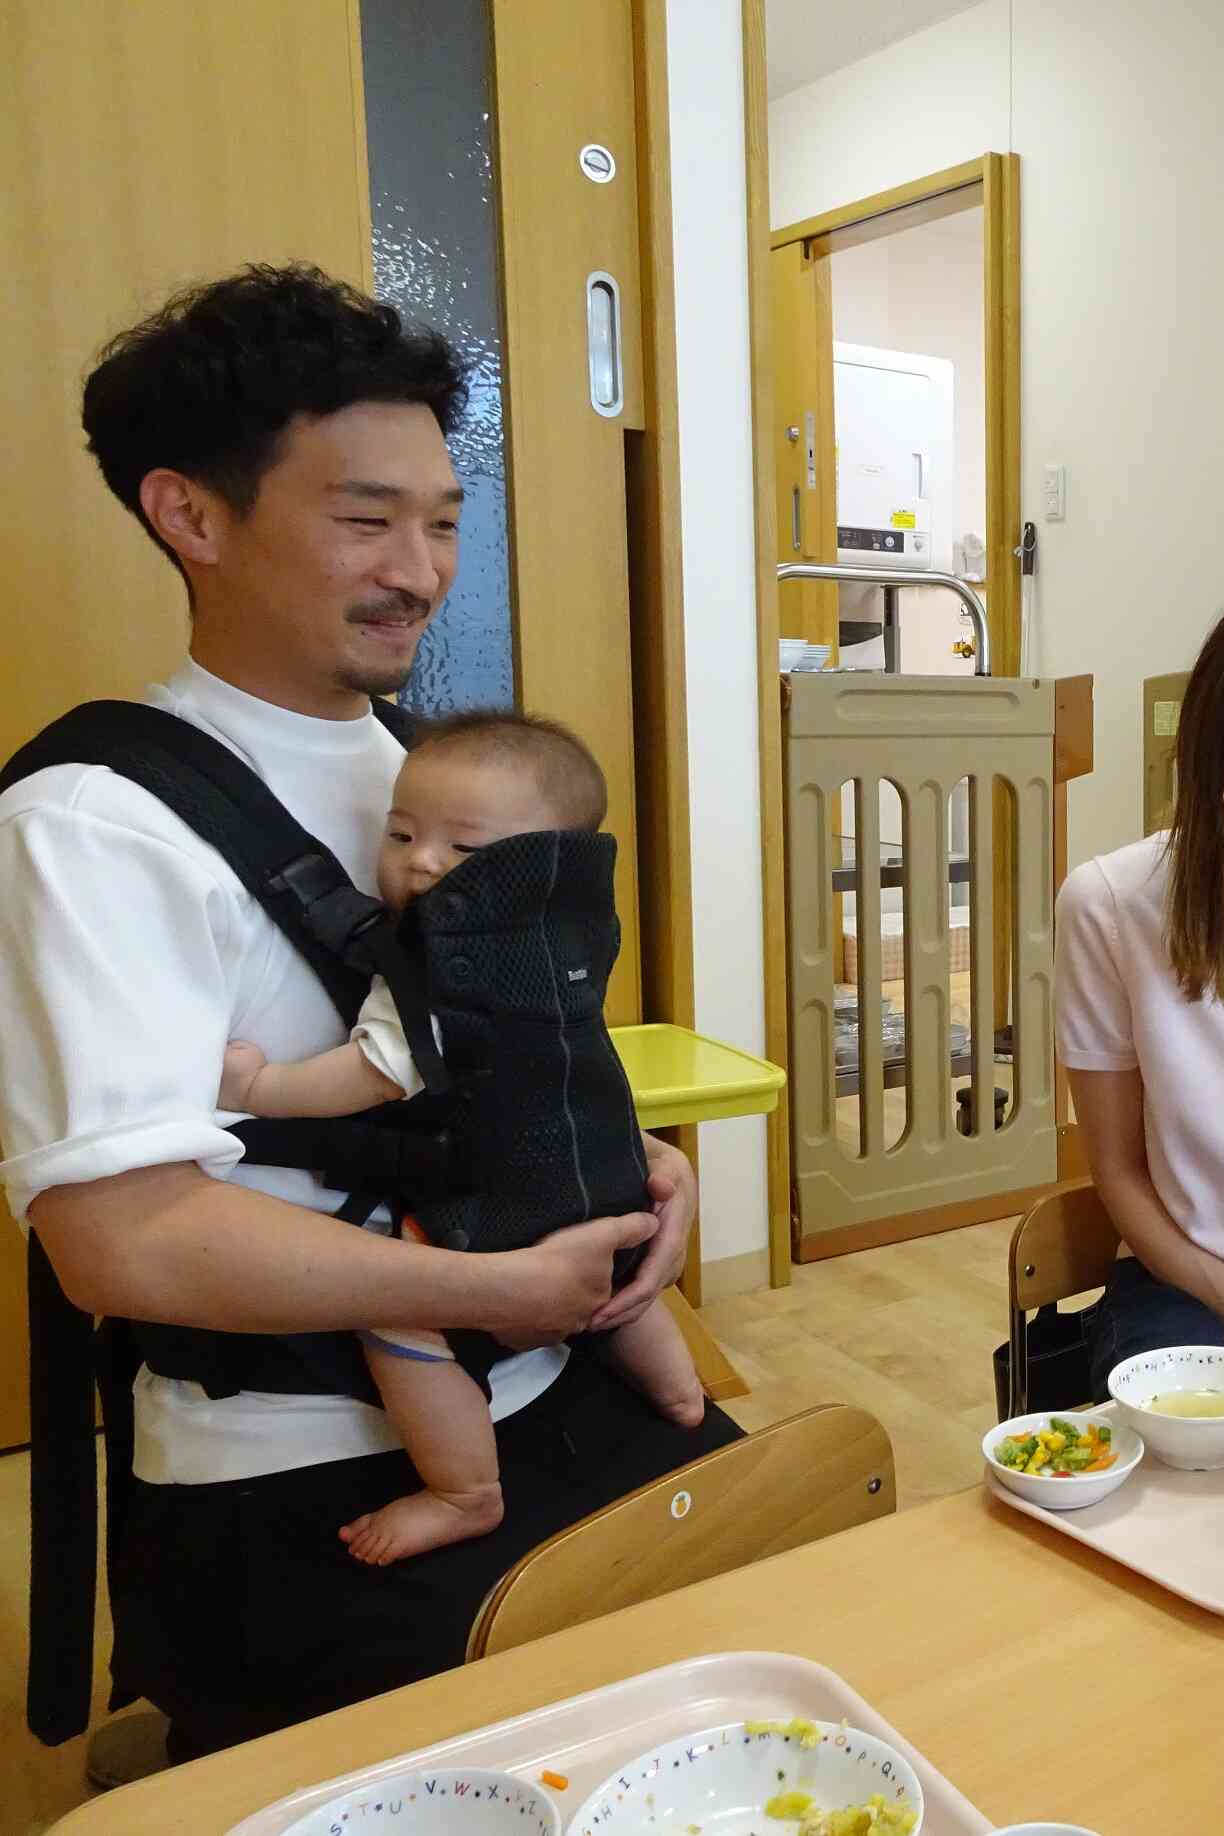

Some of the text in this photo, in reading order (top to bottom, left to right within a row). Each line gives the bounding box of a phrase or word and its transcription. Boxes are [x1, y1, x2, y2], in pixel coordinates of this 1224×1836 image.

[881, 1760, 893, 1777] Q
[425, 1779, 437, 1795] V
[453, 1780, 472, 1797] W
[487, 1783, 499, 1800] X
